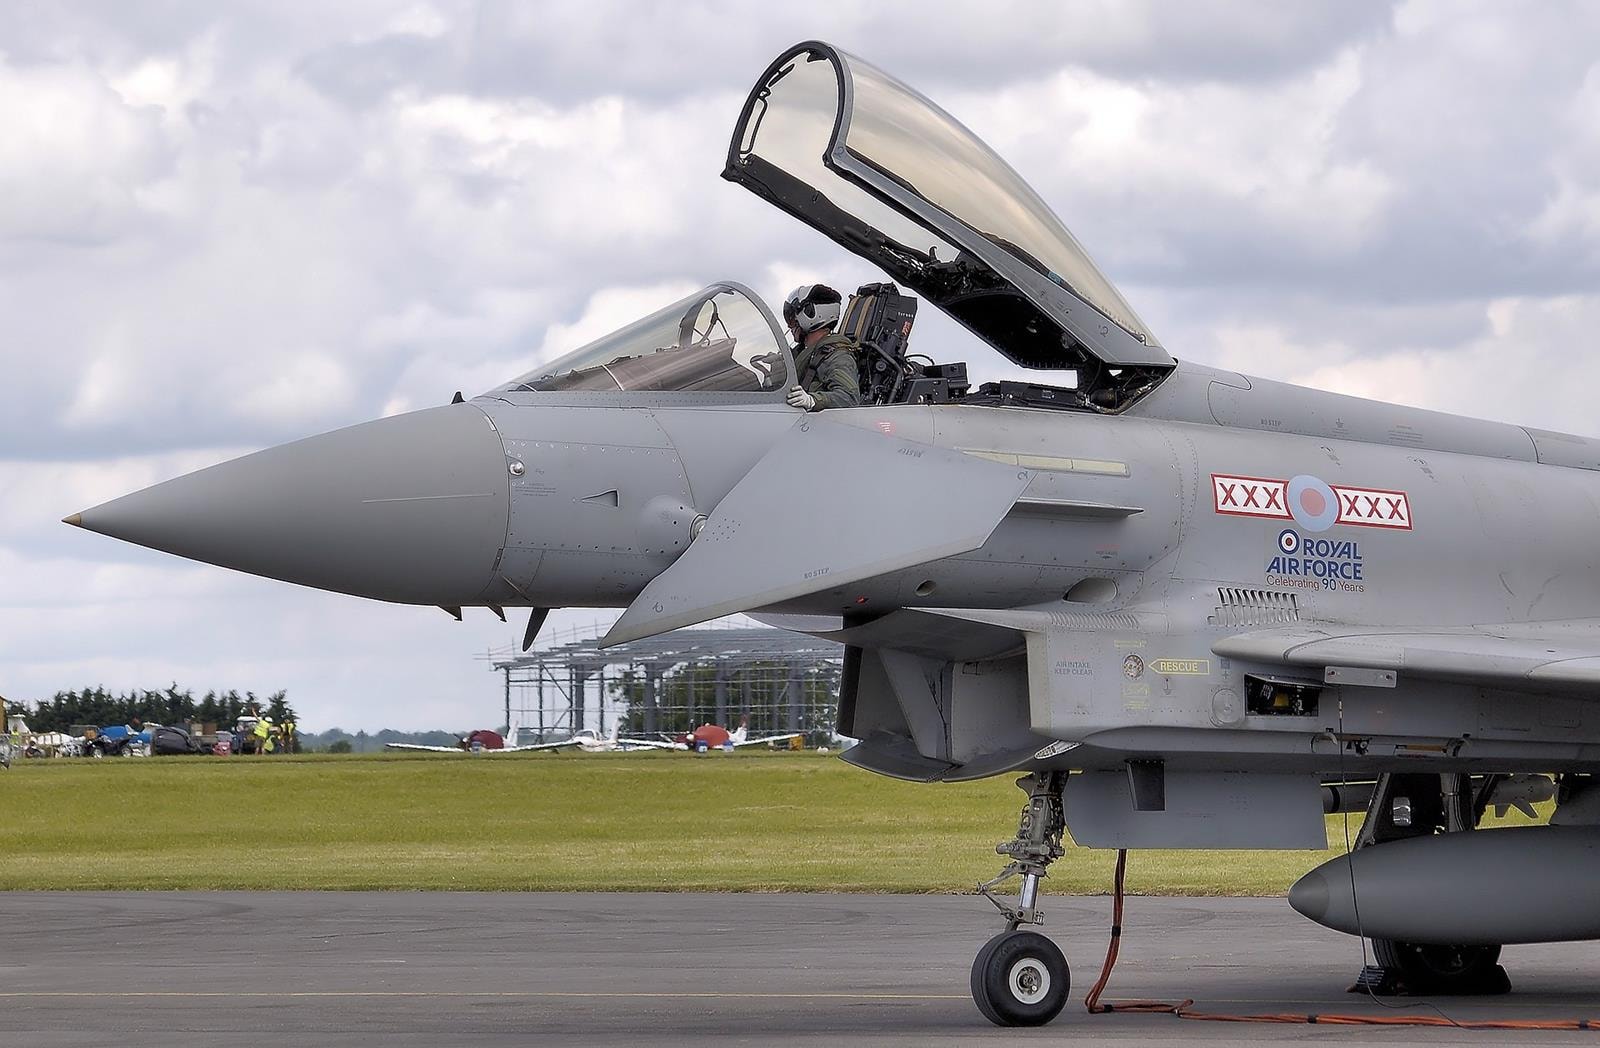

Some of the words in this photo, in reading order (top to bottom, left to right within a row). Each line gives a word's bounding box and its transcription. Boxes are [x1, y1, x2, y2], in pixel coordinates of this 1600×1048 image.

[1219, 482, 1282, 510] XXX
[1343, 493, 1405, 520] XXX
[1303, 538, 1362, 560] ROYAL
[1266, 556, 1300, 575] AIR
[1303, 559, 1363, 580] FORCE
[1266, 574, 1320, 591] Celebrating
[1321, 578, 1337, 591] 90
[1338, 581, 1365, 592] Years
[1071, 668, 1093, 676] CLEAR
[1160, 661, 1198, 672] RESCUE
